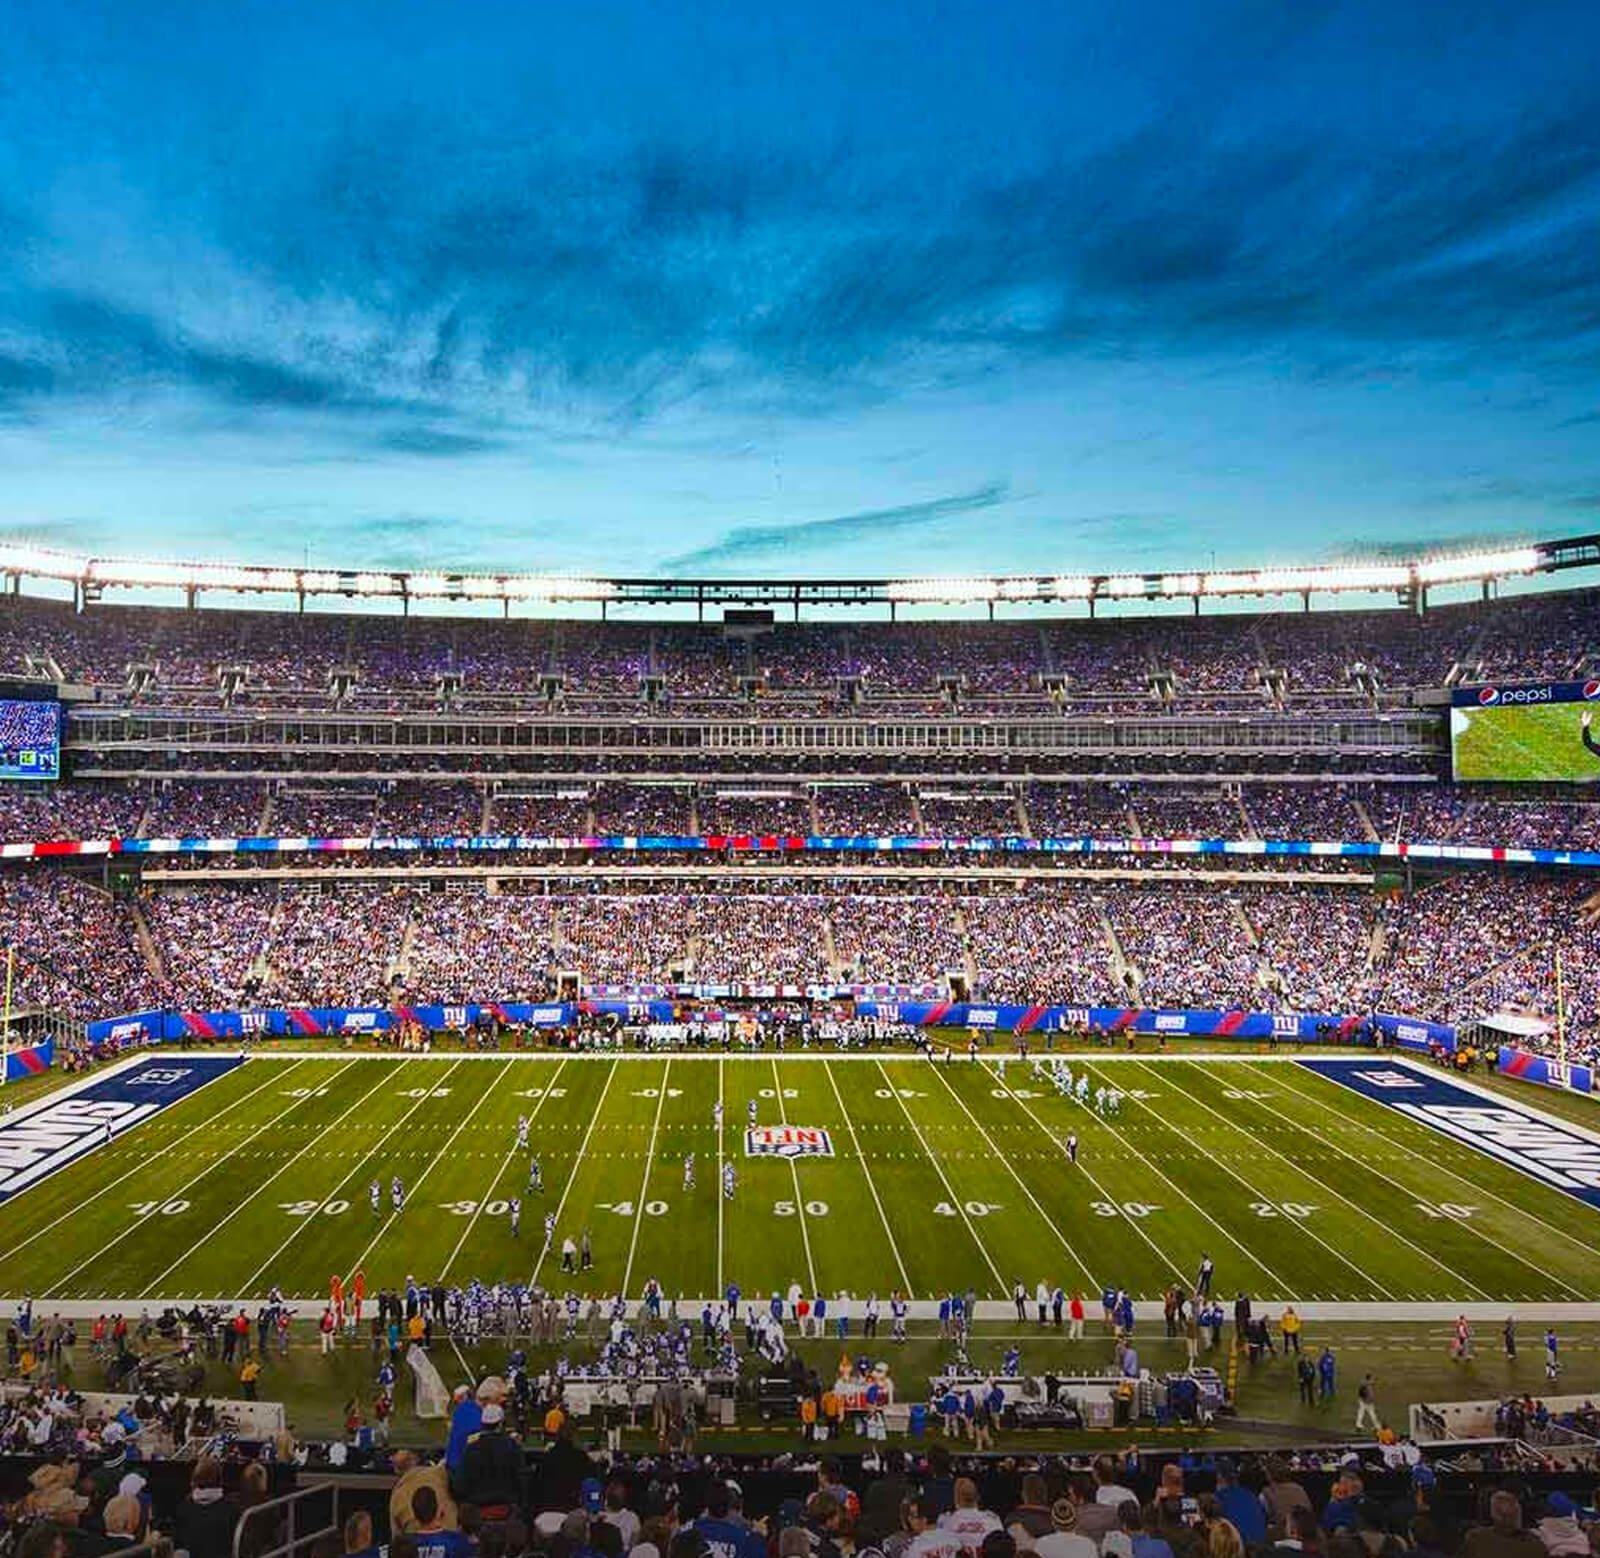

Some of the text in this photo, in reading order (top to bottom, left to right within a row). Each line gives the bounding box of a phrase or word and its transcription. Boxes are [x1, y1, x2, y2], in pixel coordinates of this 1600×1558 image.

[1502, 686, 1552, 703] pepsi
[0, 1099, 137, 1182] ANTS
[133, 1200, 191, 1215] 10
[286, 1200, 351, 1215] 20
[451, 1200, 510, 1215] 30
[611, 1201, 670, 1216] 40
[773, 1201, 829, 1216] 50
[932, 1201, 990, 1217] 40
[1089, 1201, 1151, 1217] 30
[1248, 1202, 1312, 1217] 20
[1415, 1203, 1474, 1218] 10
